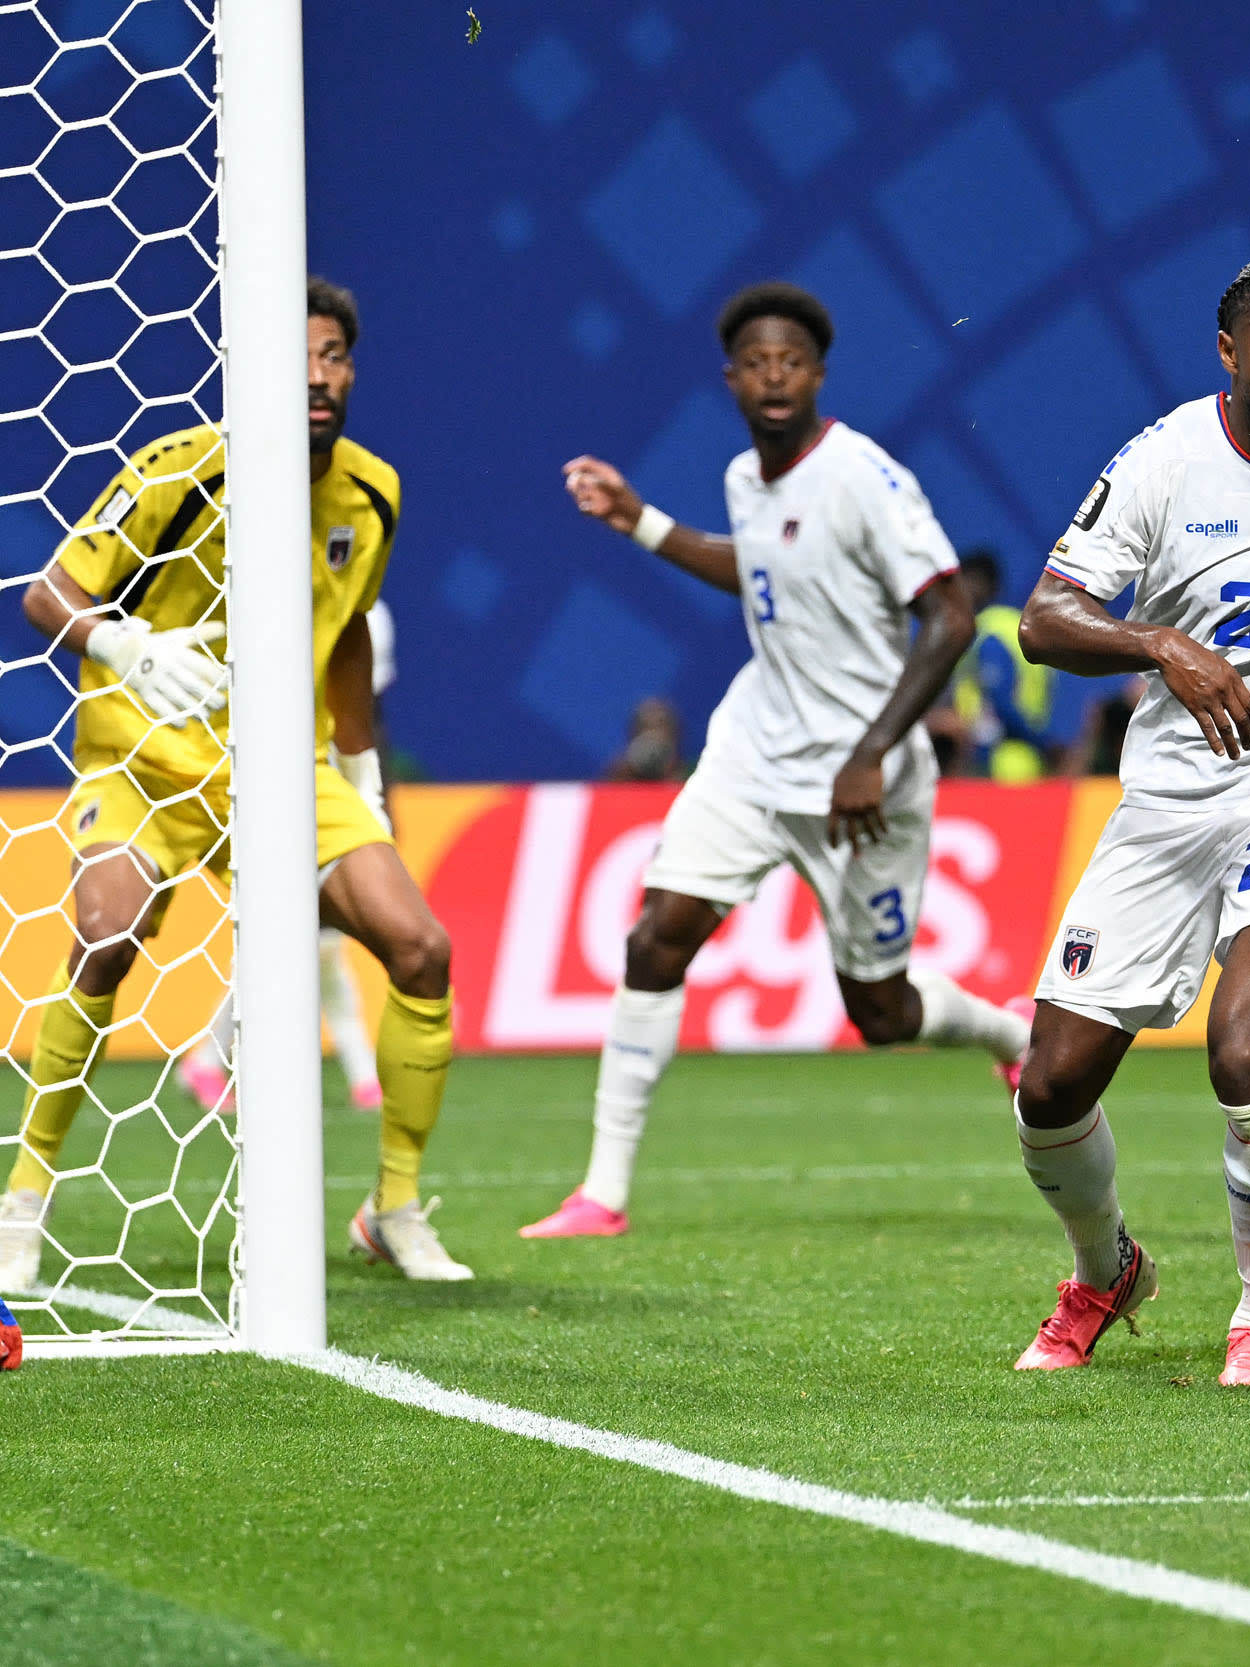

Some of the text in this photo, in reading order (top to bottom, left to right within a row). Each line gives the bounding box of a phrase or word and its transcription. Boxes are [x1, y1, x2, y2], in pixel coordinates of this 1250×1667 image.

[1185, 519, 1238, 537] capelli
[752, 568, 775, 622] 3
[870, 886, 906, 943] 3
[1067, 928, 1096, 939] FCF
